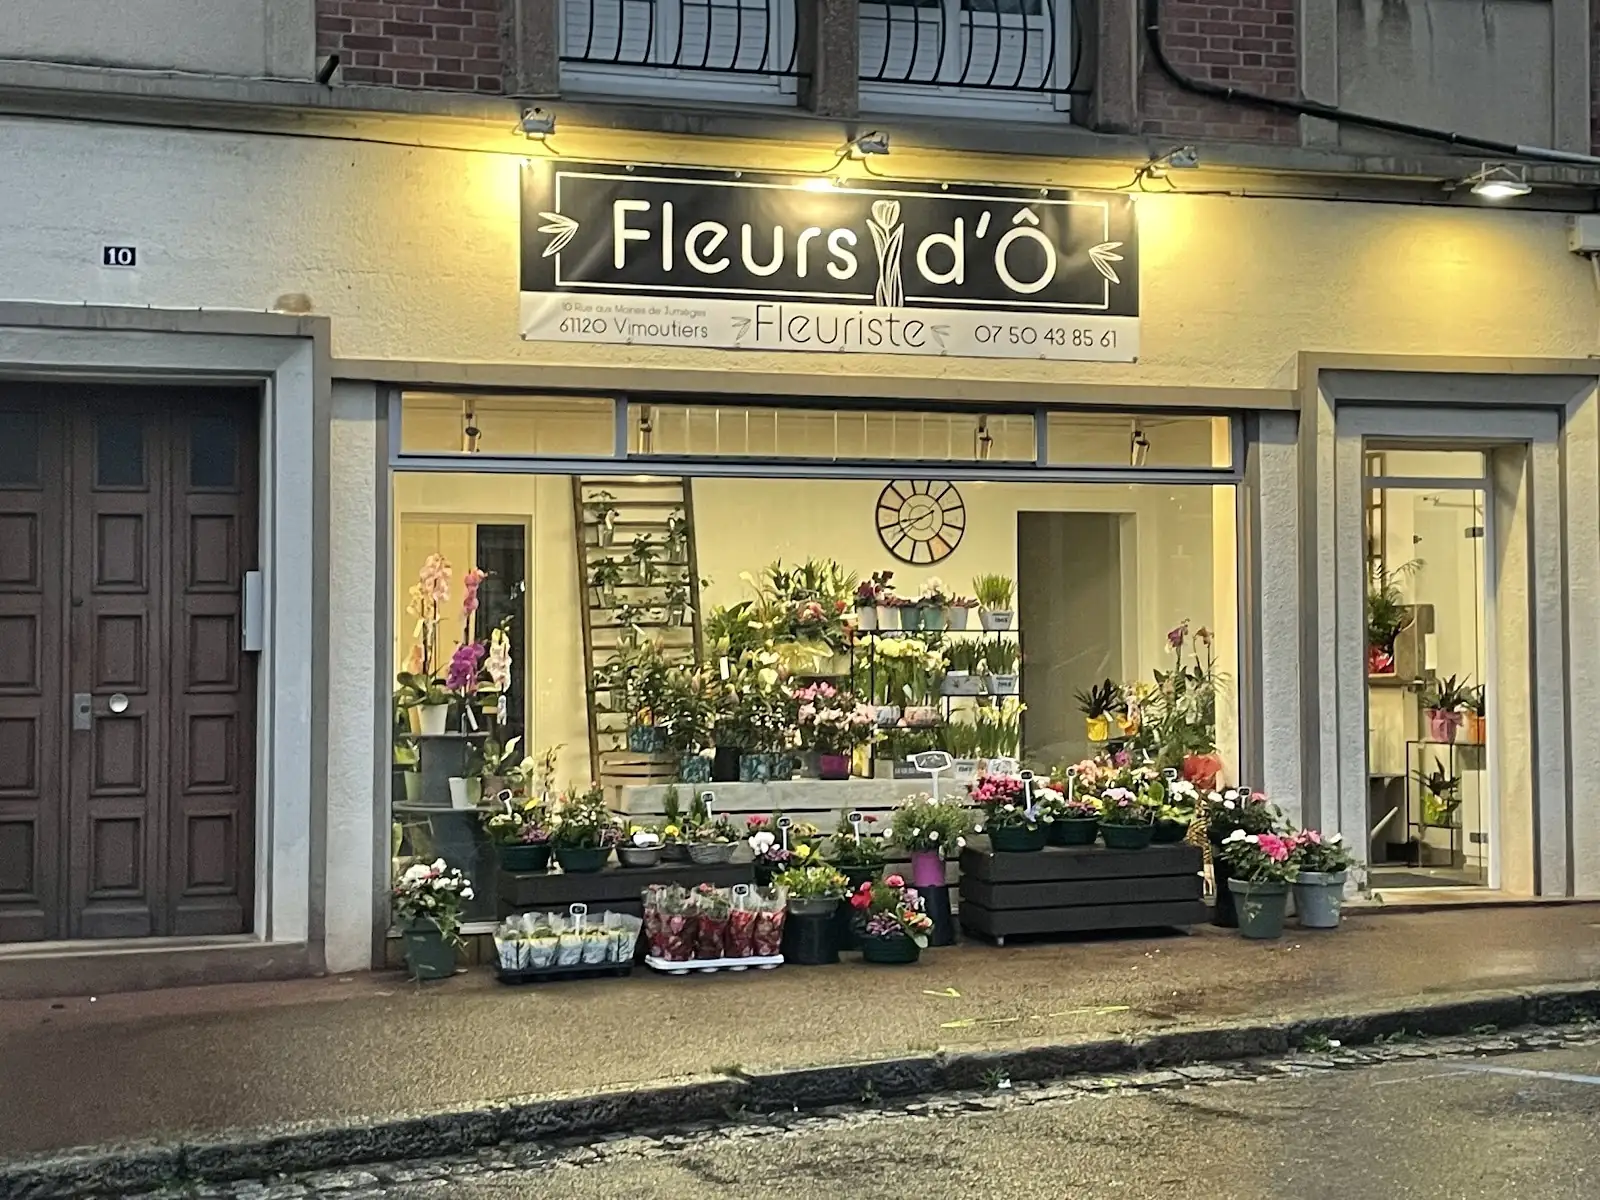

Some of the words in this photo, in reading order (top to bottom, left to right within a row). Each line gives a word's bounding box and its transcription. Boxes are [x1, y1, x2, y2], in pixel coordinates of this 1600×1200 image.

[108, 247, 132, 265] 10
[613, 198, 858, 281] Fleurs
[916, 206, 1058, 295] d'Ô
[562, 302, 573, 312] 10
[574, 302, 593, 313] Rue
[595, 305, 612, 313] aux
[615, 304, 646, 315] Moines
[649, 305, 661, 315] de
[559, 317, 607, 334] 61120
[613, 317, 708, 339] Vimoutiers
[755, 304, 926, 348] Fleuriste
[974, 325, 1003, 343] 07
[1009, 326, 1038, 345] 50
[1043, 328, 1066, 346] 43
[1072, 329, 1094, 347] 85
[1100, 330, 1116, 348] 61
